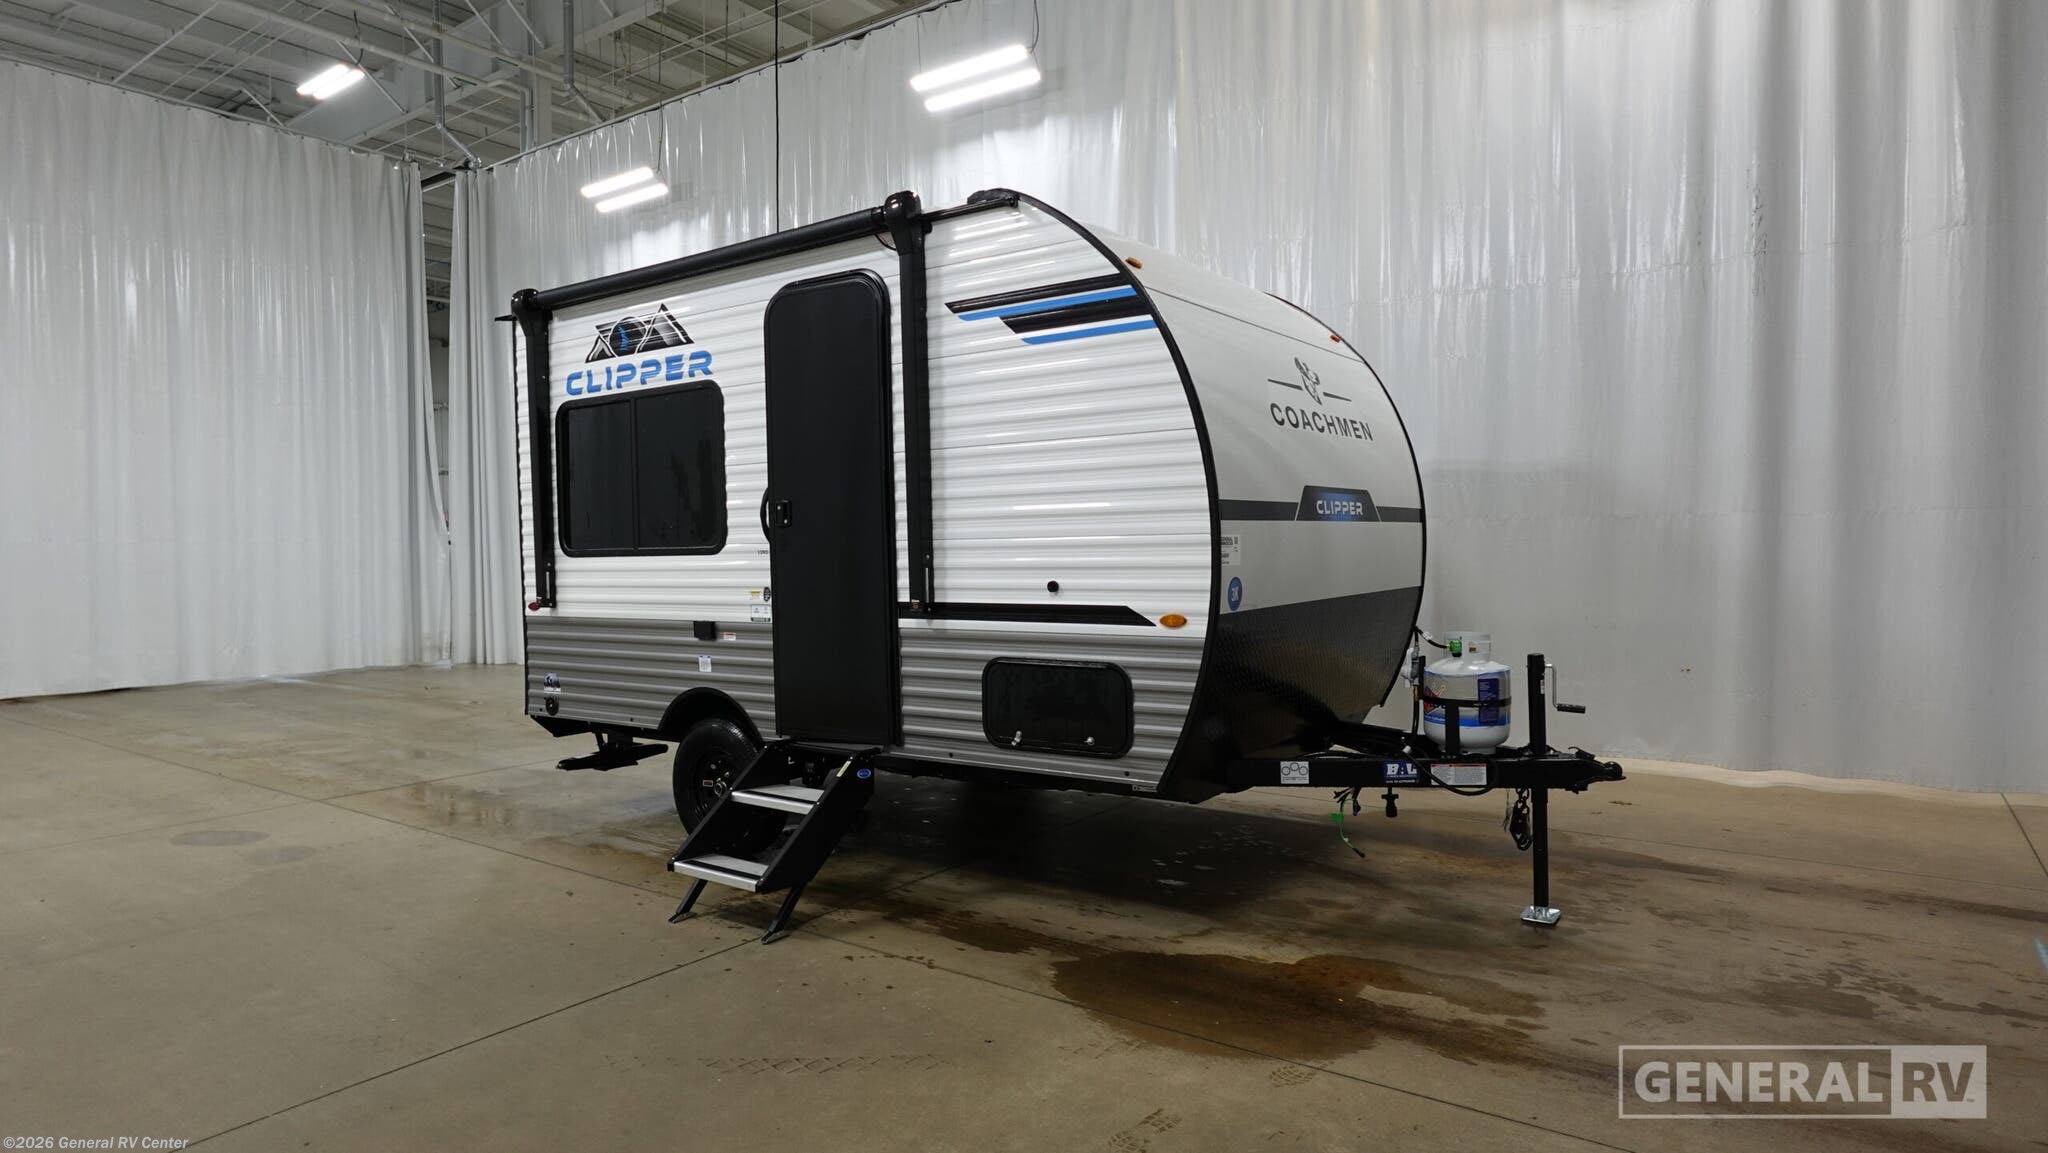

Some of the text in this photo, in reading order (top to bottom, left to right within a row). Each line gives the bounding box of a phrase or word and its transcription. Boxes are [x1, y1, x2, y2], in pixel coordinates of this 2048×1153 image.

[566, 350, 713, 396] CLIPPER
[1270, 403, 1373, 441] COACHMEN
[1316, 500, 1364, 516] CLIPPER
